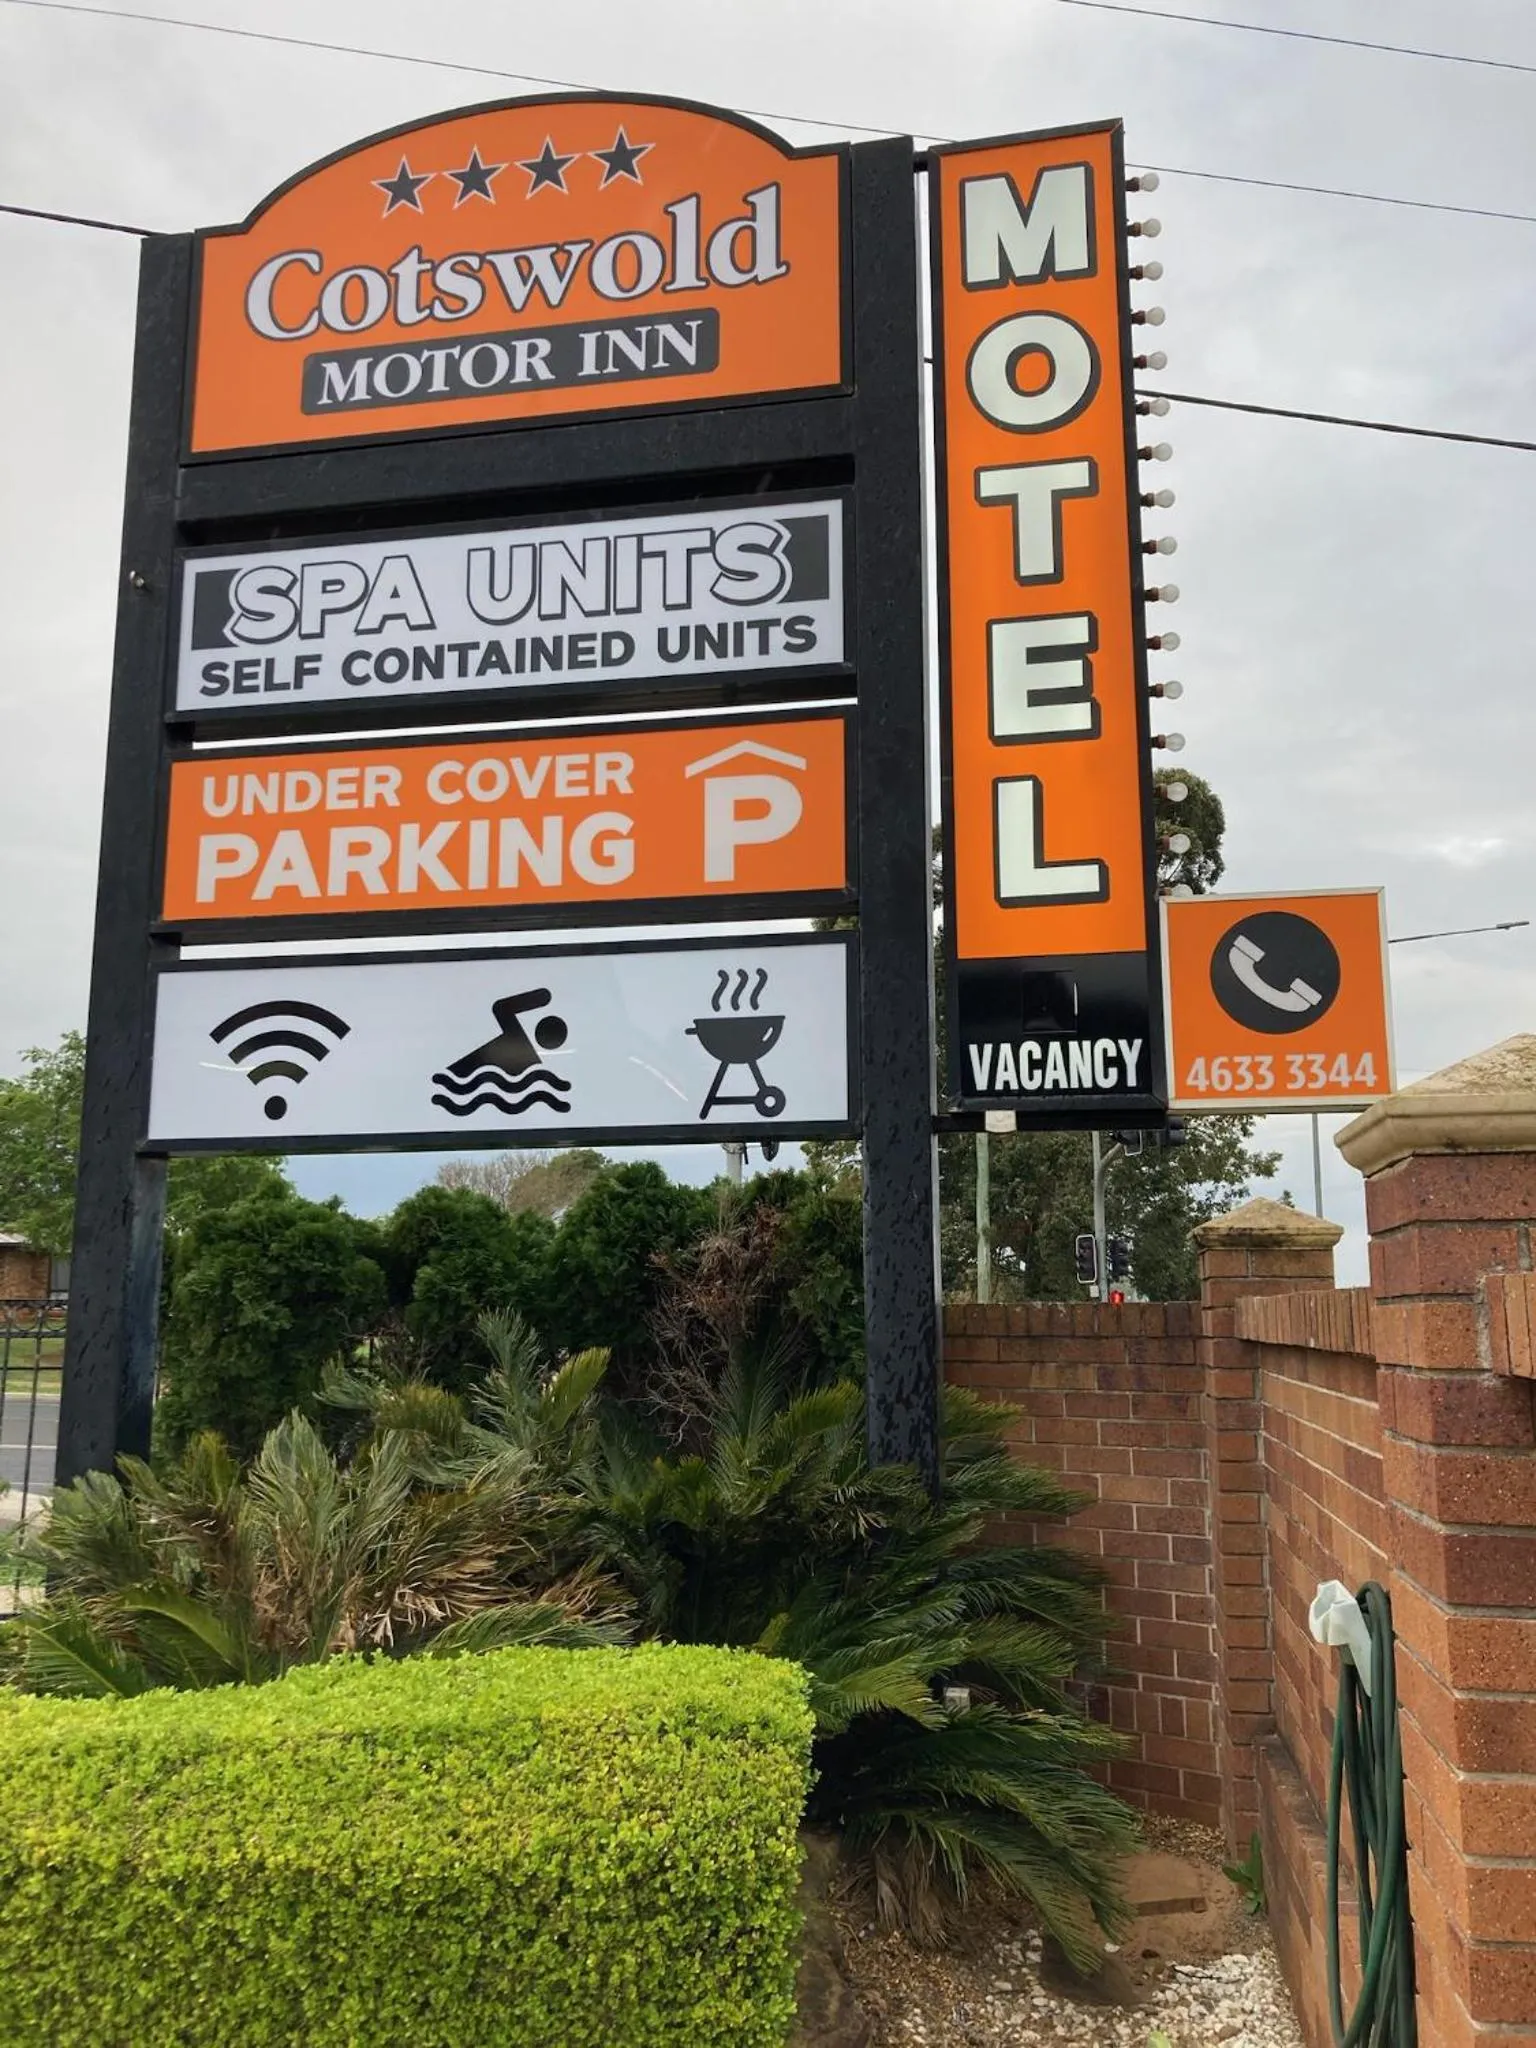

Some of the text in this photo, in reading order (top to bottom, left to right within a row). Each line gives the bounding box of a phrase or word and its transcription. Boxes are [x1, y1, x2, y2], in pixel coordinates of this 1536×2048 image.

[245, 182, 789, 339] Cotswold
[317, 319, 704, 405] MOTOR INN
[959, 160, 1109, 907] MOTEL
[225, 522, 792, 646] SPA UNITS
[199, 614, 818, 697] SELF CONTAINED UNITS
[201, 751, 635, 818] UNDER COVER
[703, 773, 804, 884] P
[195, 811, 636, 904] PARKING
[968, 1037, 1143, 1092] VACANCY
[1185, 1051, 1377, 1093] 4633 3344
